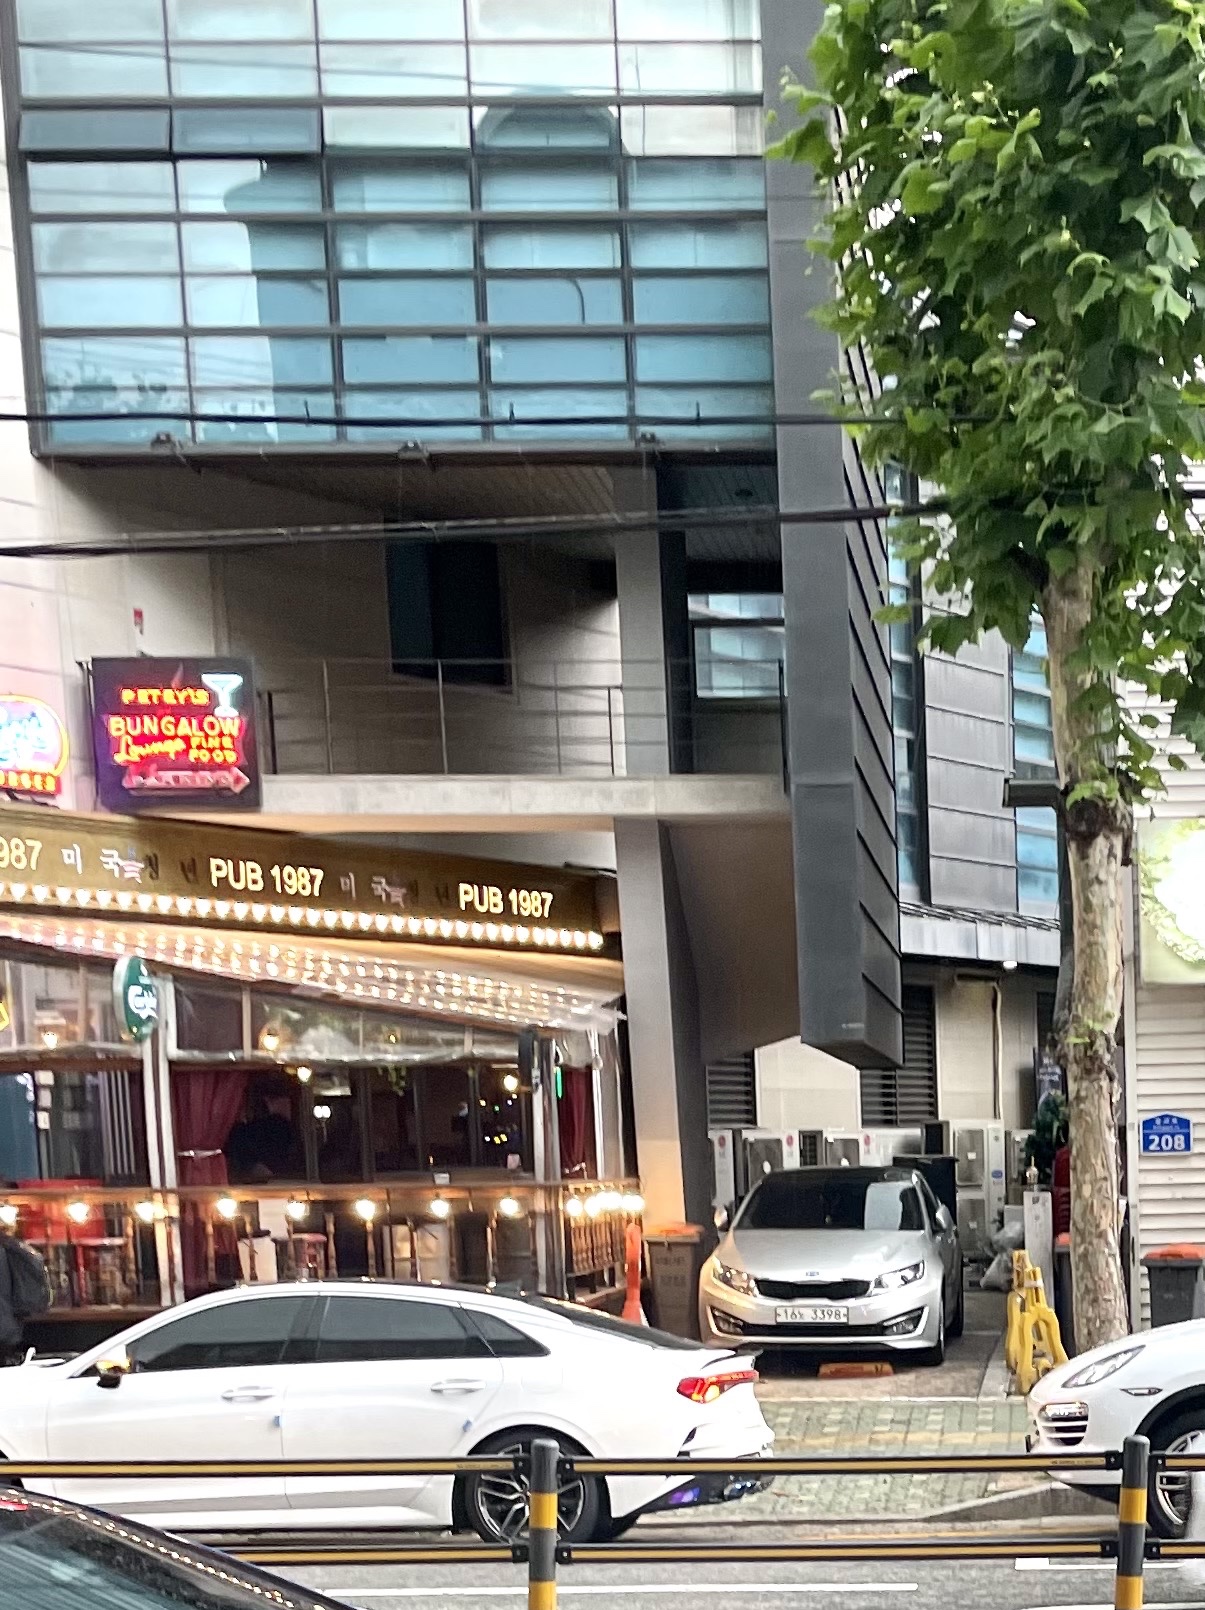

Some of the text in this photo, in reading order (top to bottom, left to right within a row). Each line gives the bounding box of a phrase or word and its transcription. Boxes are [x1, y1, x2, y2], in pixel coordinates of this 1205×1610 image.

[109, 715, 239, 737] BUNGALOW
[114, 735, 186, 763] Lounge
[190, 736, 233, 749] FINE
[188, 749, 237, 763] FOOD
[209, 858, 264, 891] PUB
[270, 864, 324, 896] 1987
[459, 883, 503, 913] PUB
[509, 888, 553, 918] 1987
[1149, 1134, 1185, 1151] 208
[811, 1308, 842, 1321] 3398
